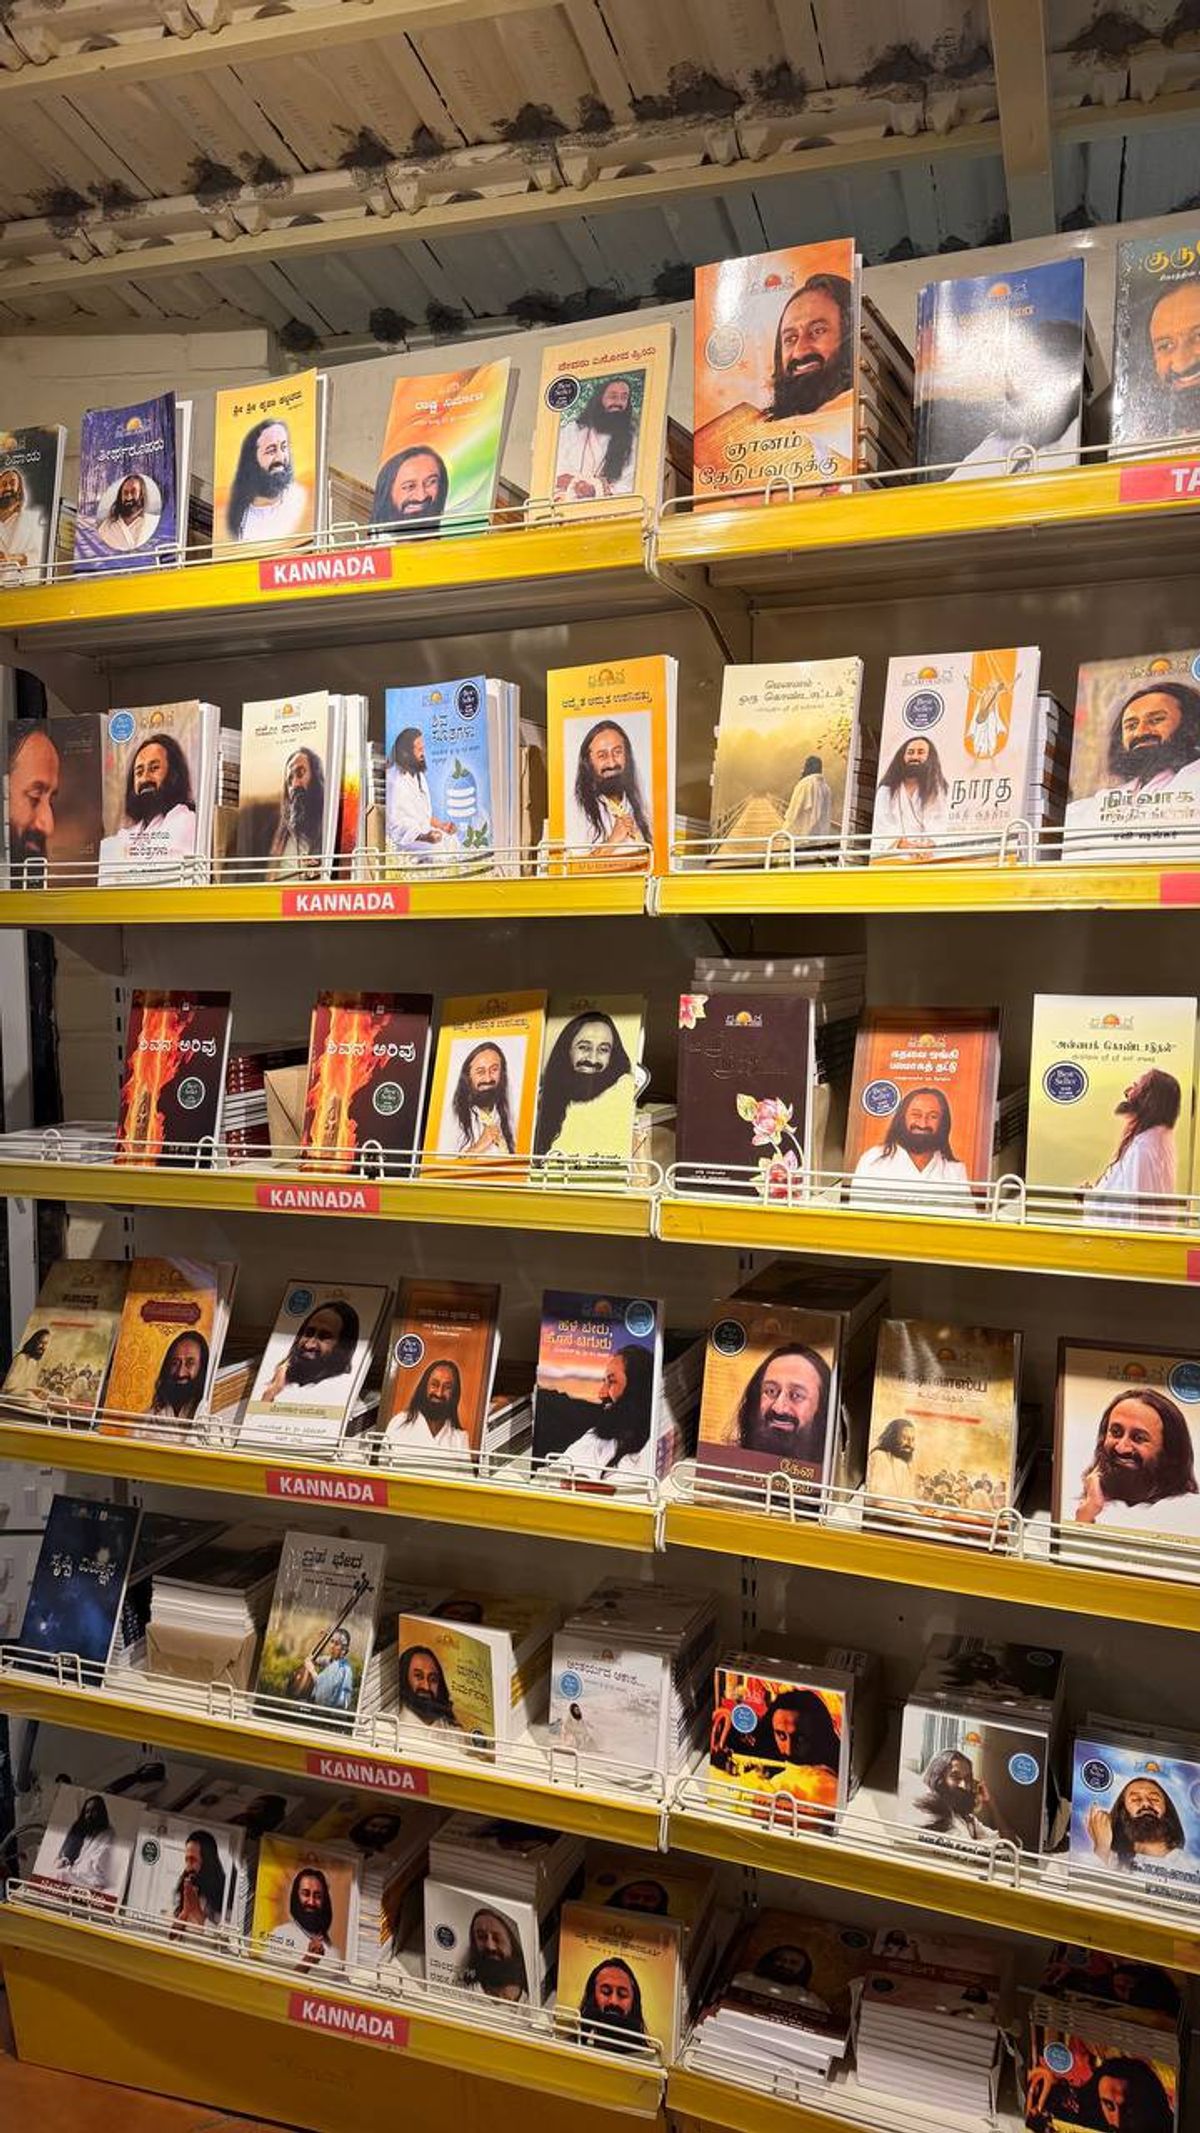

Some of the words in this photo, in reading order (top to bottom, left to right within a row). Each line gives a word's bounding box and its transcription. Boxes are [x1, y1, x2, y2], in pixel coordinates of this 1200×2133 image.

[725, 431, 801, 465] ஞானம்
[699, 459, 838, 490] தேடுபவருக்கு
[273, 555, 376, 584] KANNADA
[950, 777, 1012, 809] நாரத
[296, 891, 394, 912] KANNADA
[178, 1036, 217, 1057] ಅರಿವು
[326, 1037, 366, 1056] ಶಿವನ
[373, 1039, 417, 1062] ಅರಿವು
[271, 1189, 366, 1208] KANNADA
[280, 1477, 375, 1502] KANNADA
[320, 1759, 415, 1789] KANNADA
[302, 2000, 395, 2040] KANNADA
